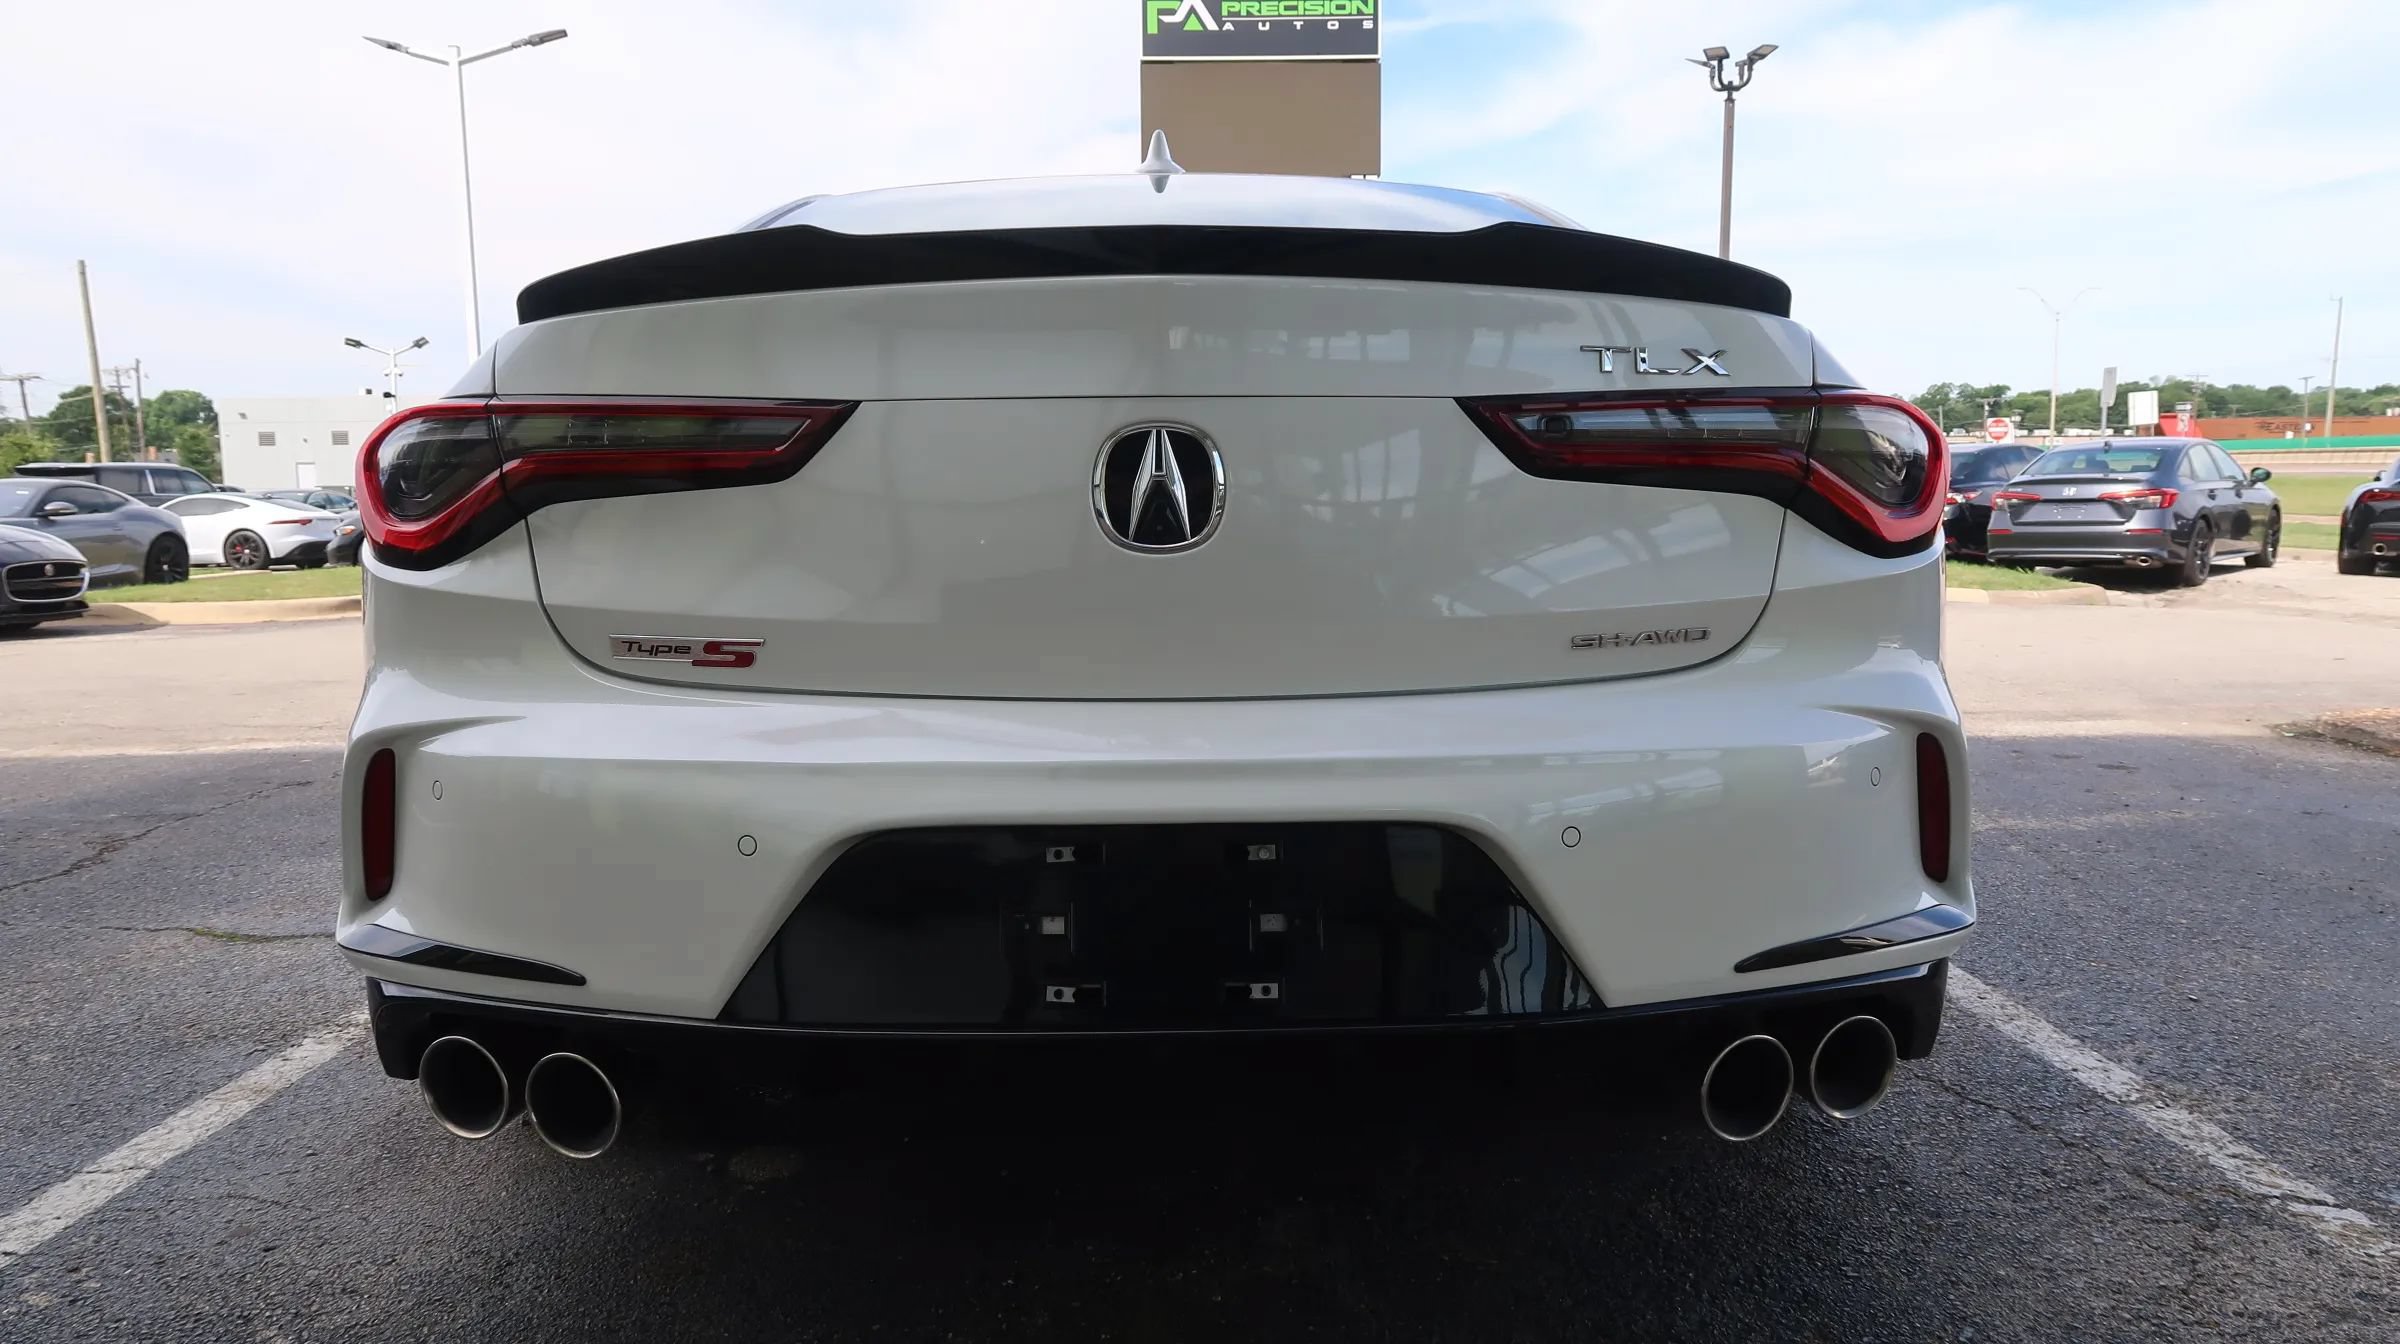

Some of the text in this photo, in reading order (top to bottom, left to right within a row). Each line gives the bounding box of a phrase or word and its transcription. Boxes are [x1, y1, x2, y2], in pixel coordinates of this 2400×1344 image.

[1222, 0, 1374, 16] PRECISION
[1222, 20, 1374, 31] AUTOS
[1580, 345, 1731, 376] TLX
[1571, 626, 1711, 649] SH-AWD
[621, 640, 762, 668] Type S
